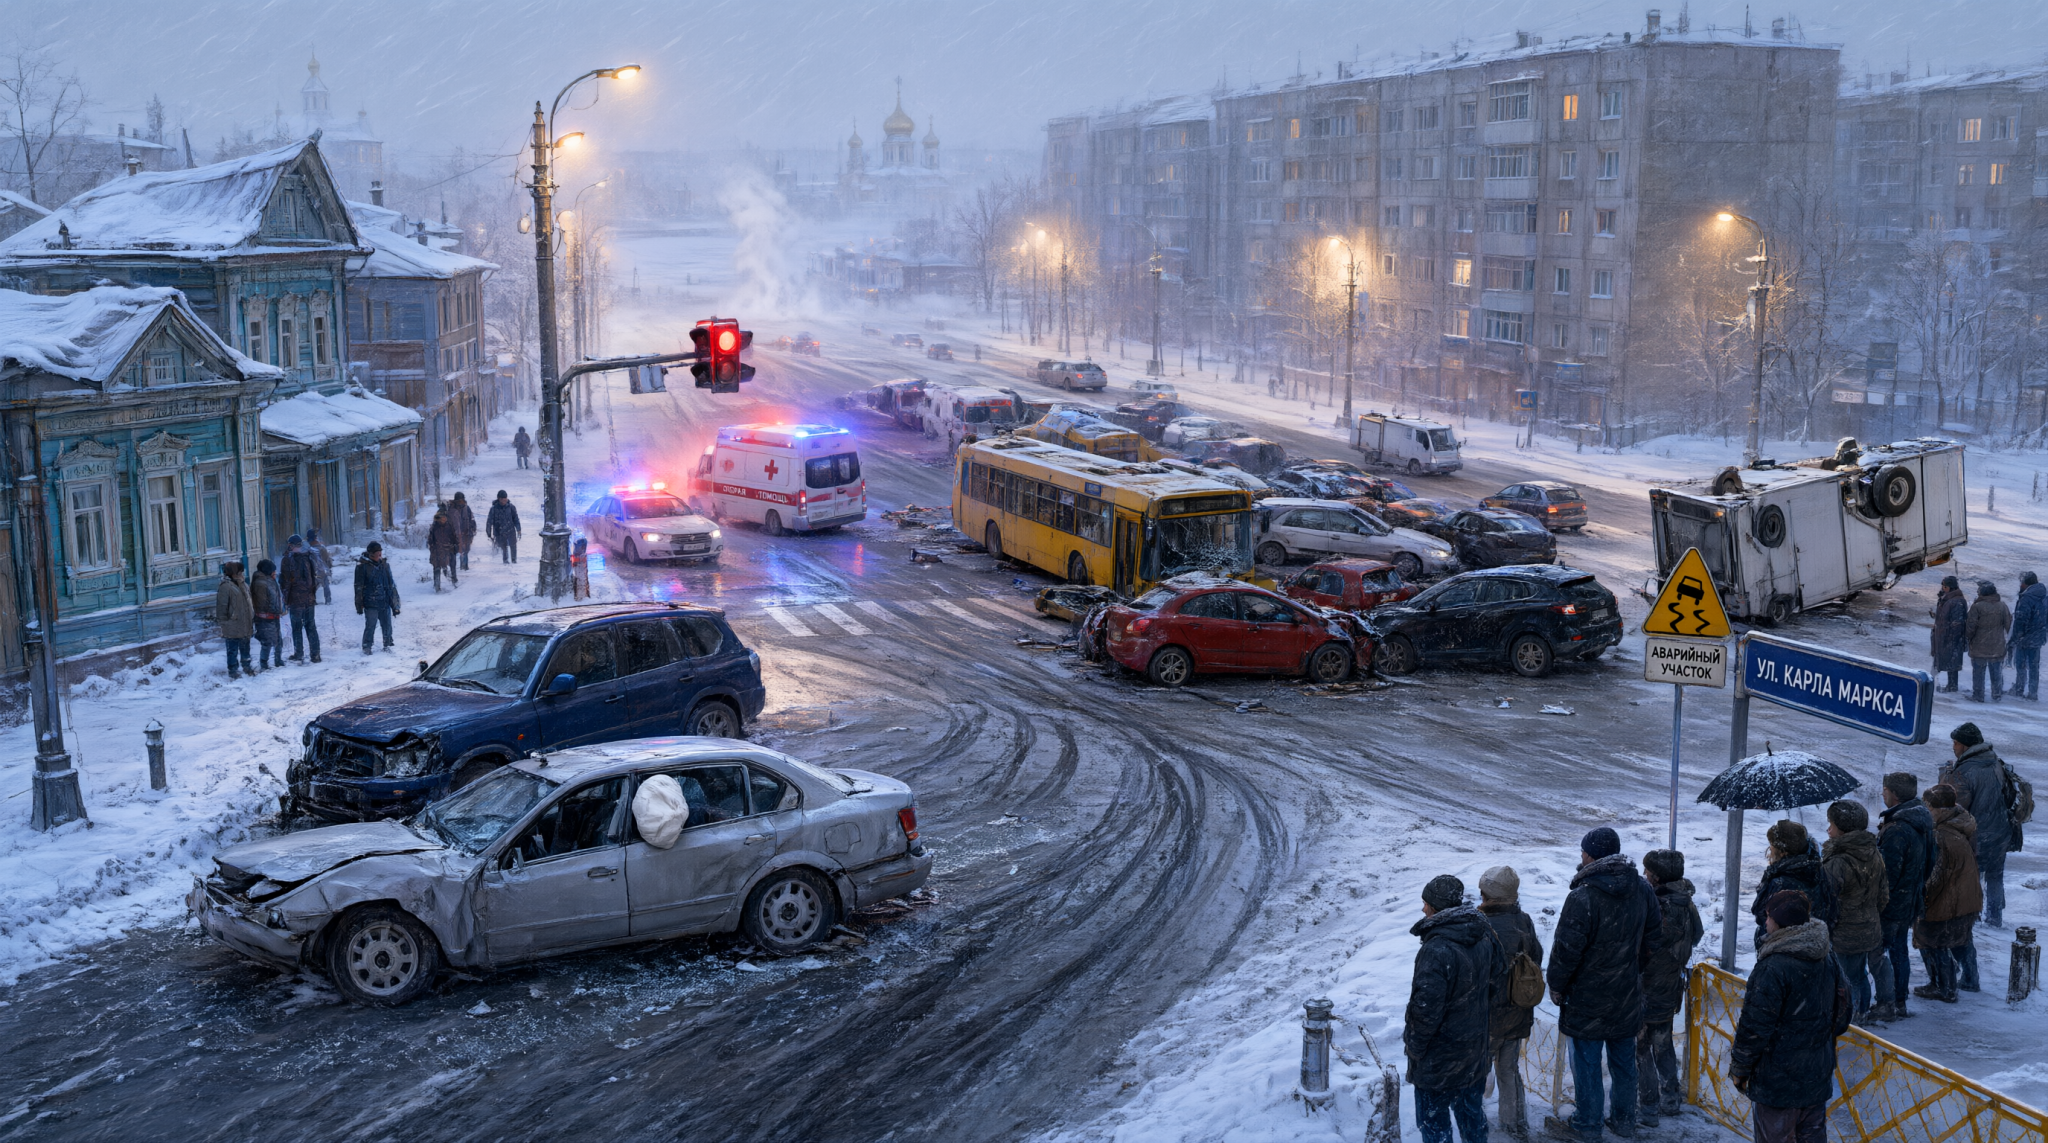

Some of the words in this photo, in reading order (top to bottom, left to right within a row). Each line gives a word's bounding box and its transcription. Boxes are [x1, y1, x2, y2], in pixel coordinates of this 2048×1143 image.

[1651, 646, 1721, 664] АВАРИЙНЫЙ
[1661, 663, 1712, 680] УЧАСТОК
[1757, 657, 1778, 683] УЛ.
[1783, 664, 1833, 698] КАРЛА
[1838, 679, 1905, 719] МАРКСА
